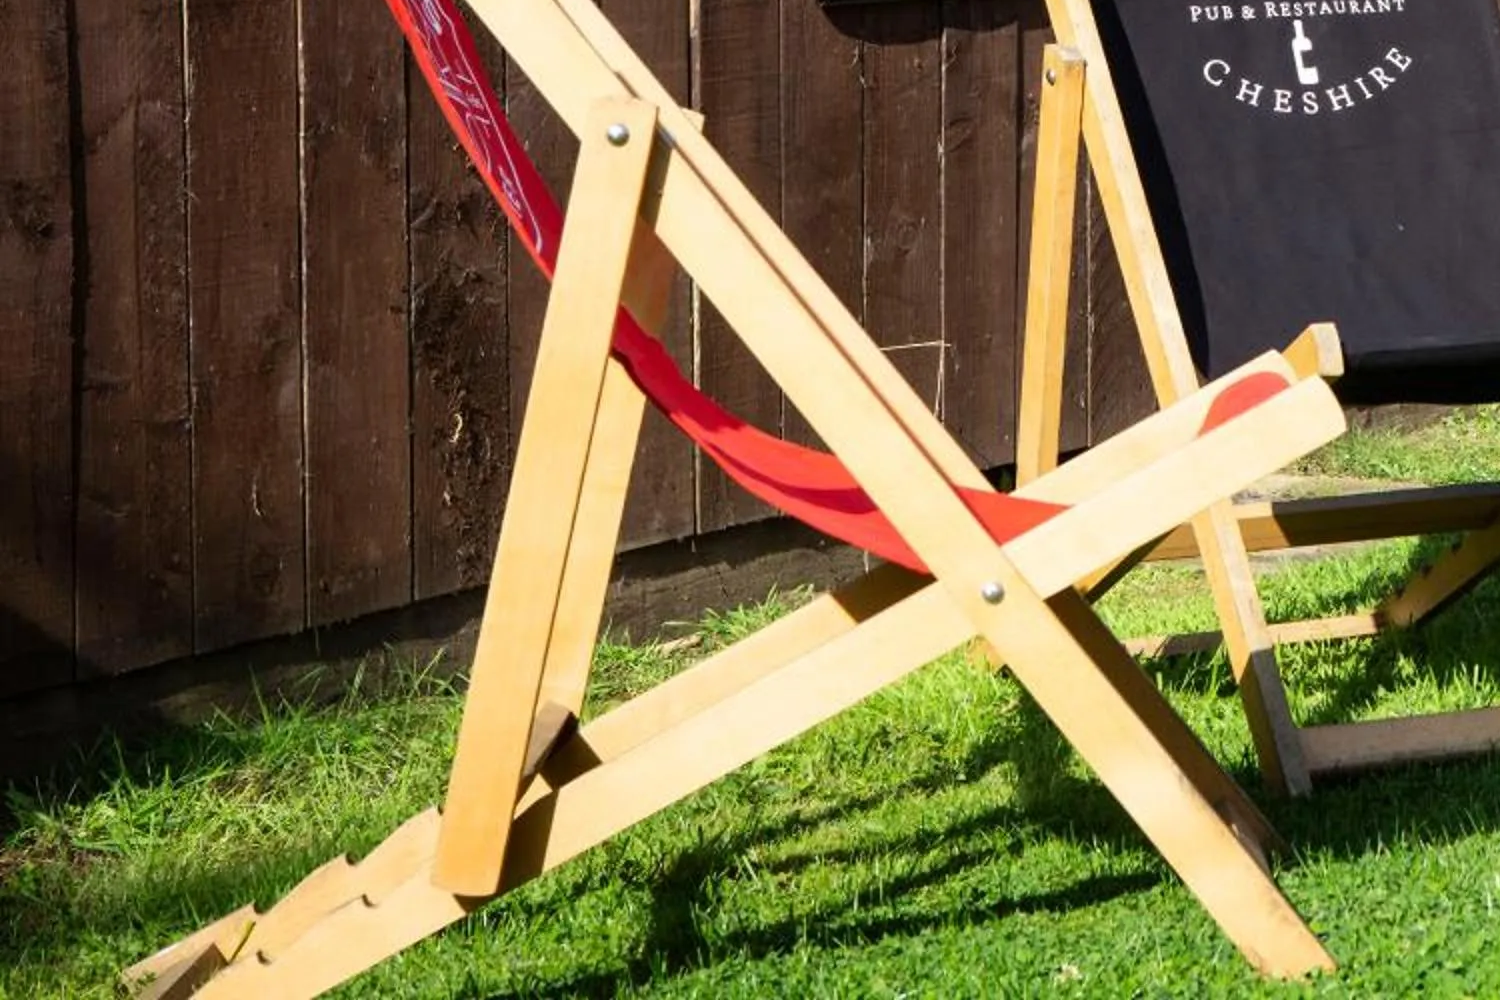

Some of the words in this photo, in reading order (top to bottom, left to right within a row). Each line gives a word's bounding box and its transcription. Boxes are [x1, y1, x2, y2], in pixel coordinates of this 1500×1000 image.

[1190, 3, 1234, 23] PUB
[1241, 4, 1257, 20] &
[1203, 47, 1413, 115] CHESHIRE
